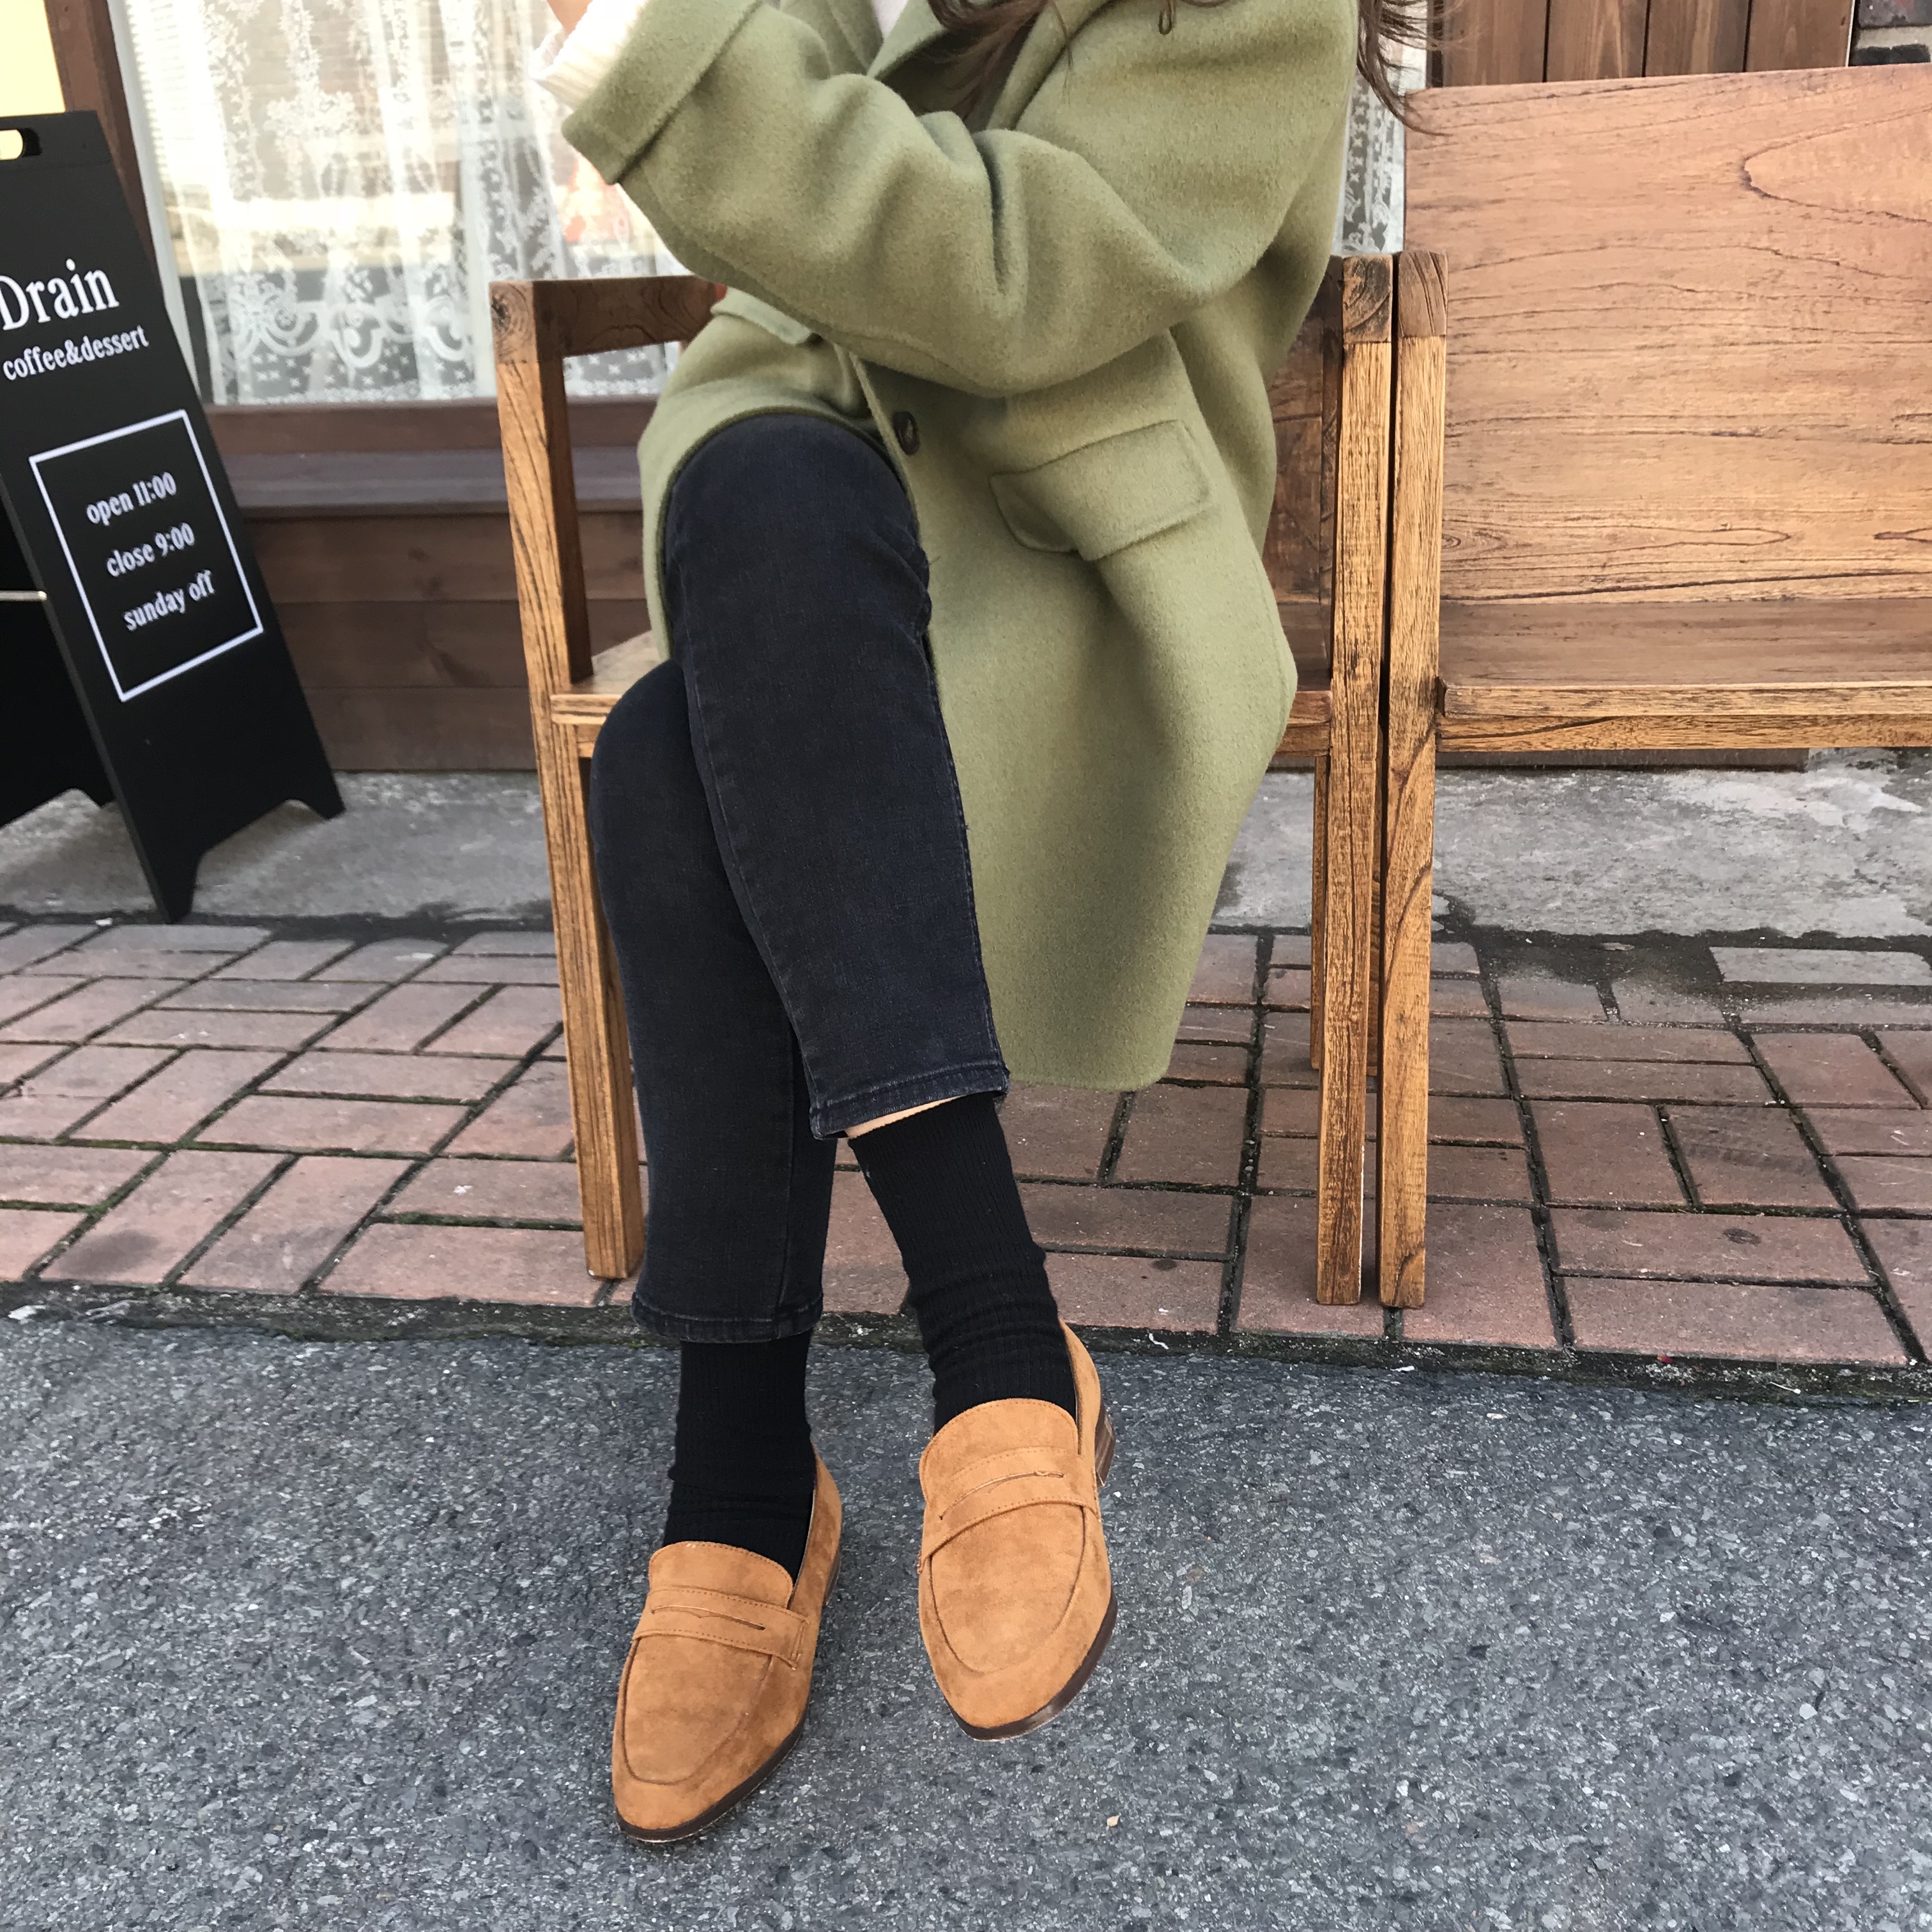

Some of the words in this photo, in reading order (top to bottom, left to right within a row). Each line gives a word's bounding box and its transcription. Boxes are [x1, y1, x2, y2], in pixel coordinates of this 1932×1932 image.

[0, 258, 119, 330] Drain
[3, 325, 149, 381] coffee&dessert
[86, 493, 134, 526] open
[132, 471, 177, 507] 11:00
[106, 542, 155, 577] close
[155, 523, 195, 557] 9:00
[124, 586, 186, 631] sunday
[189, 569, 215, 601] off
